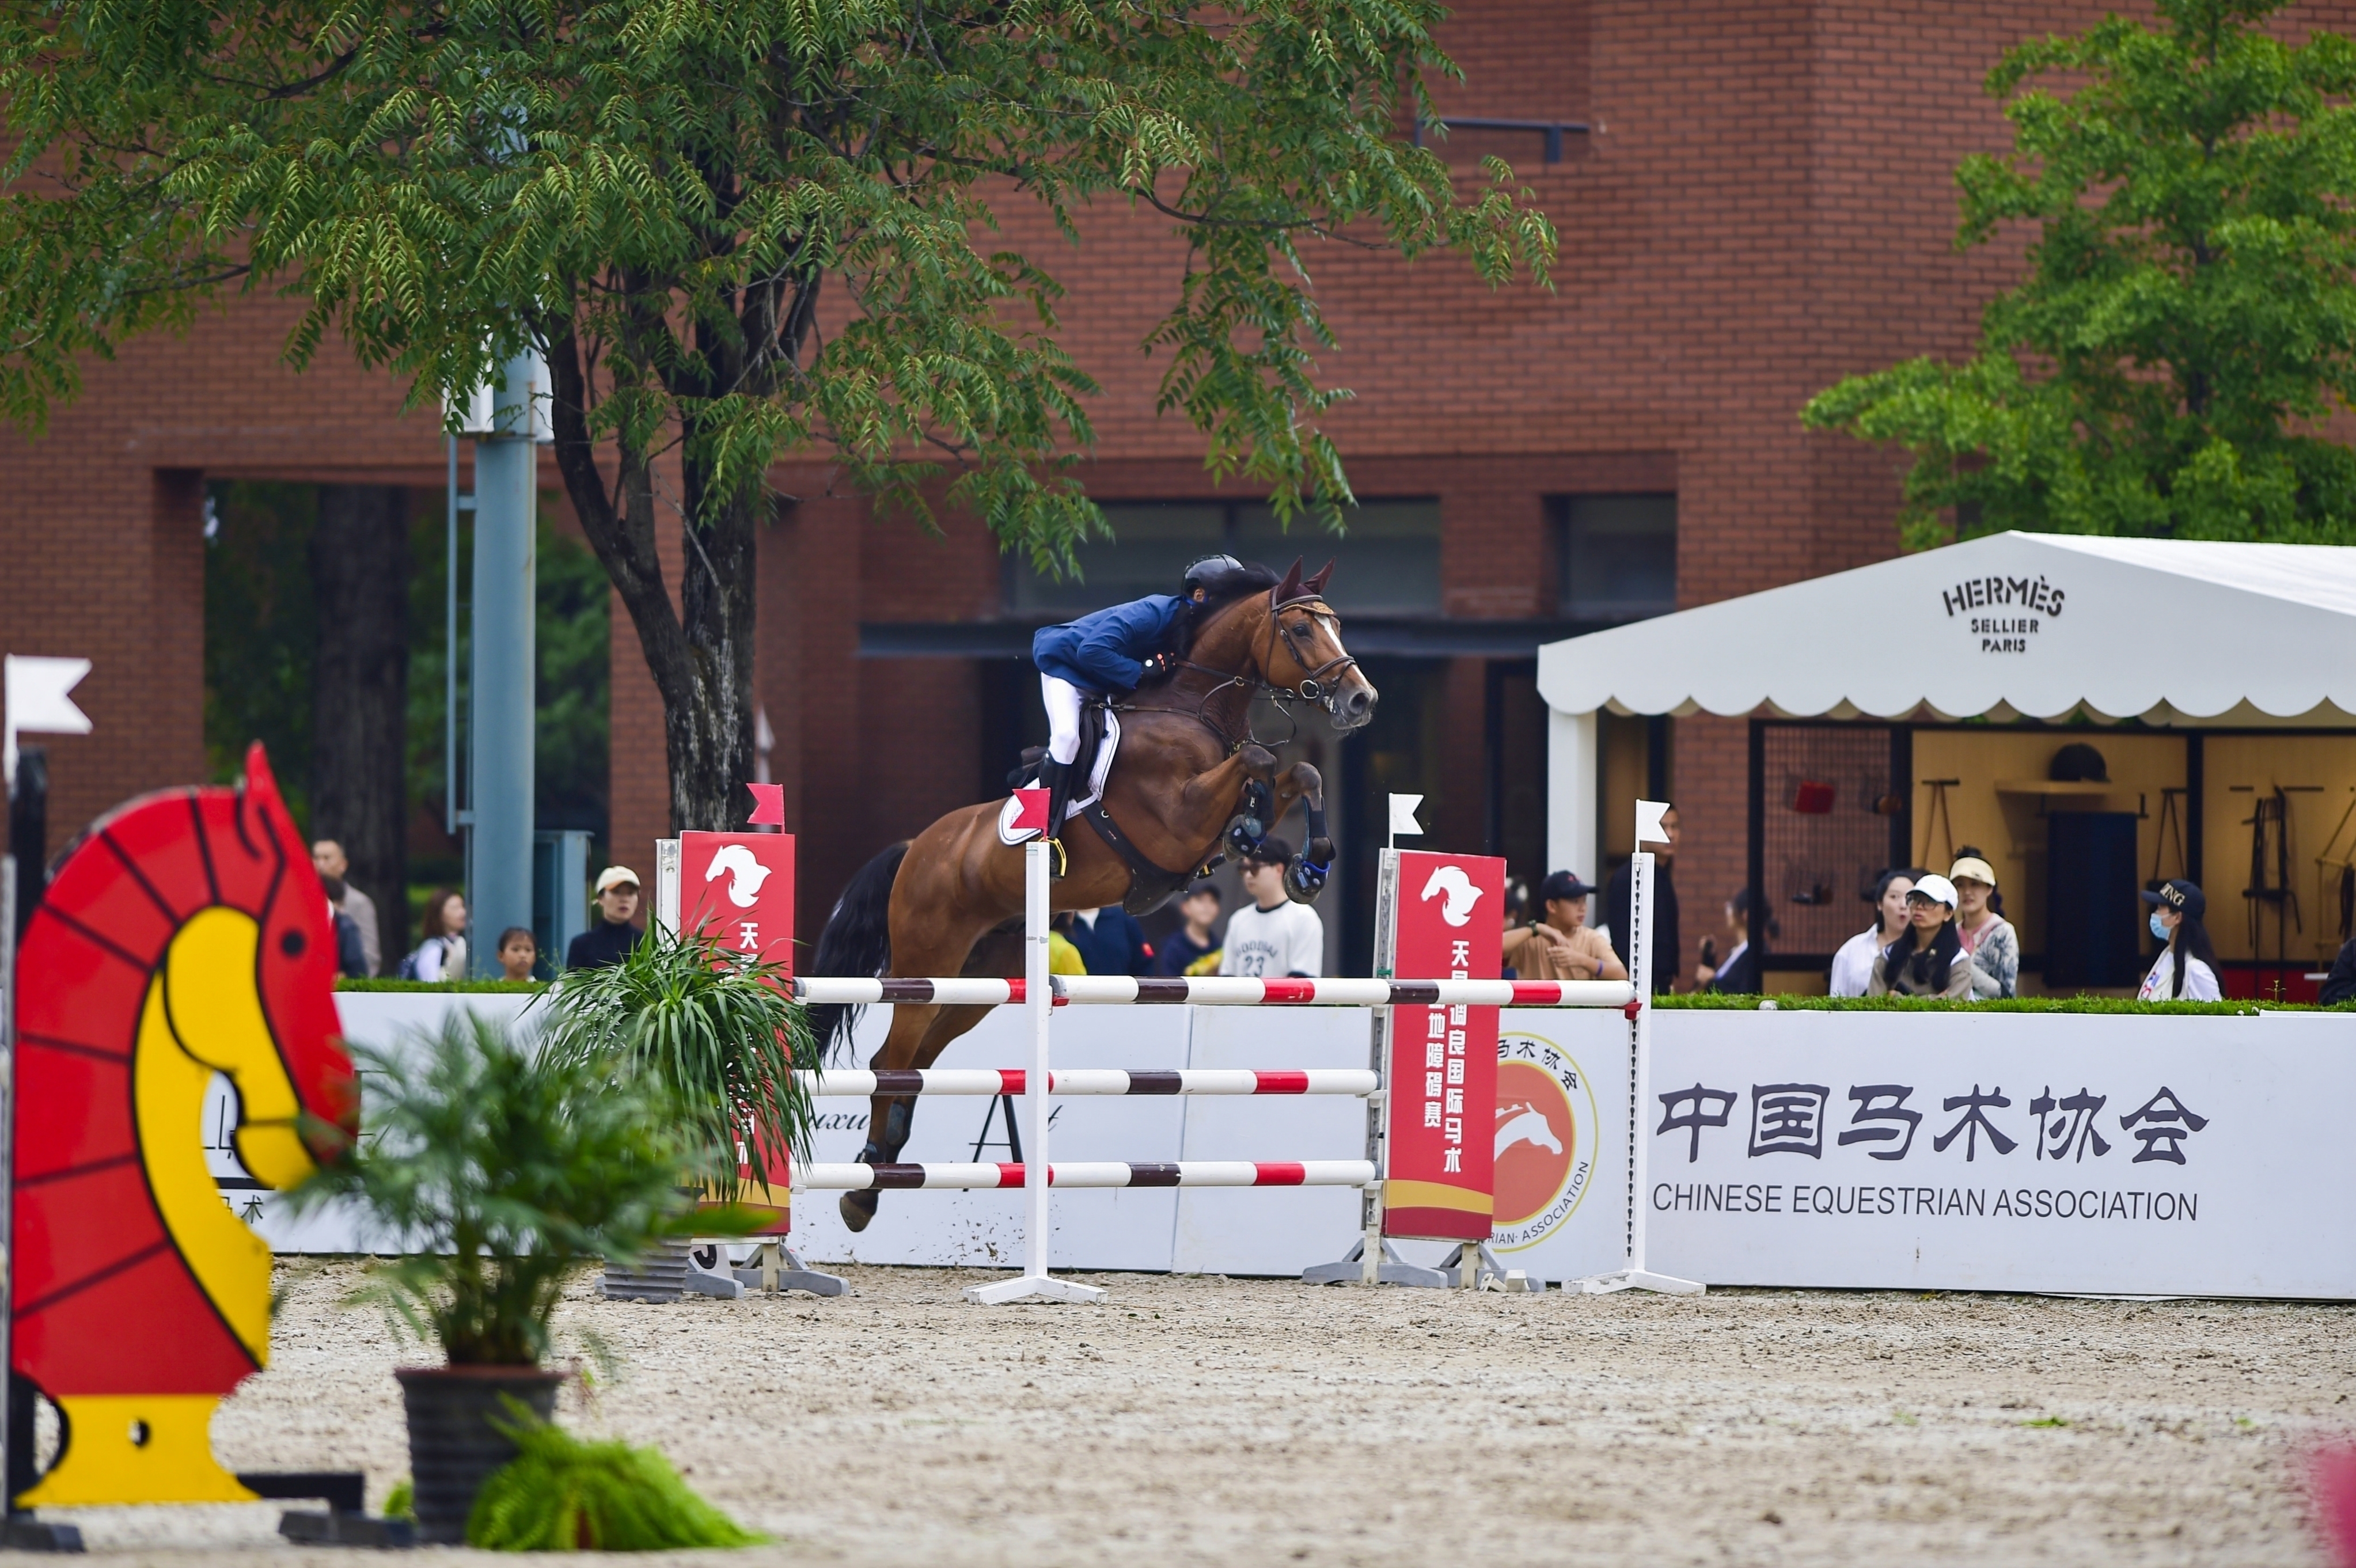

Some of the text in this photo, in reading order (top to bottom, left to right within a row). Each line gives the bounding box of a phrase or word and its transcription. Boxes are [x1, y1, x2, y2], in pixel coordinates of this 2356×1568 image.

[1943, 575, 2065, 617] HERMÈS
[1971, 618, 2039, 633] SELLIER
[1982, 639, 2026, 653] PARIS
[1424, 1004, 1446, 1127] 地障碍赛
[1656, 1083, 2210, 1165] 中国马术协会
[1522, 1161, 1589, 1242] ASSOCIATION
[1653, 1183, 2198, 1221] CHINESE EQUESTRIAN ASSOCIATION
